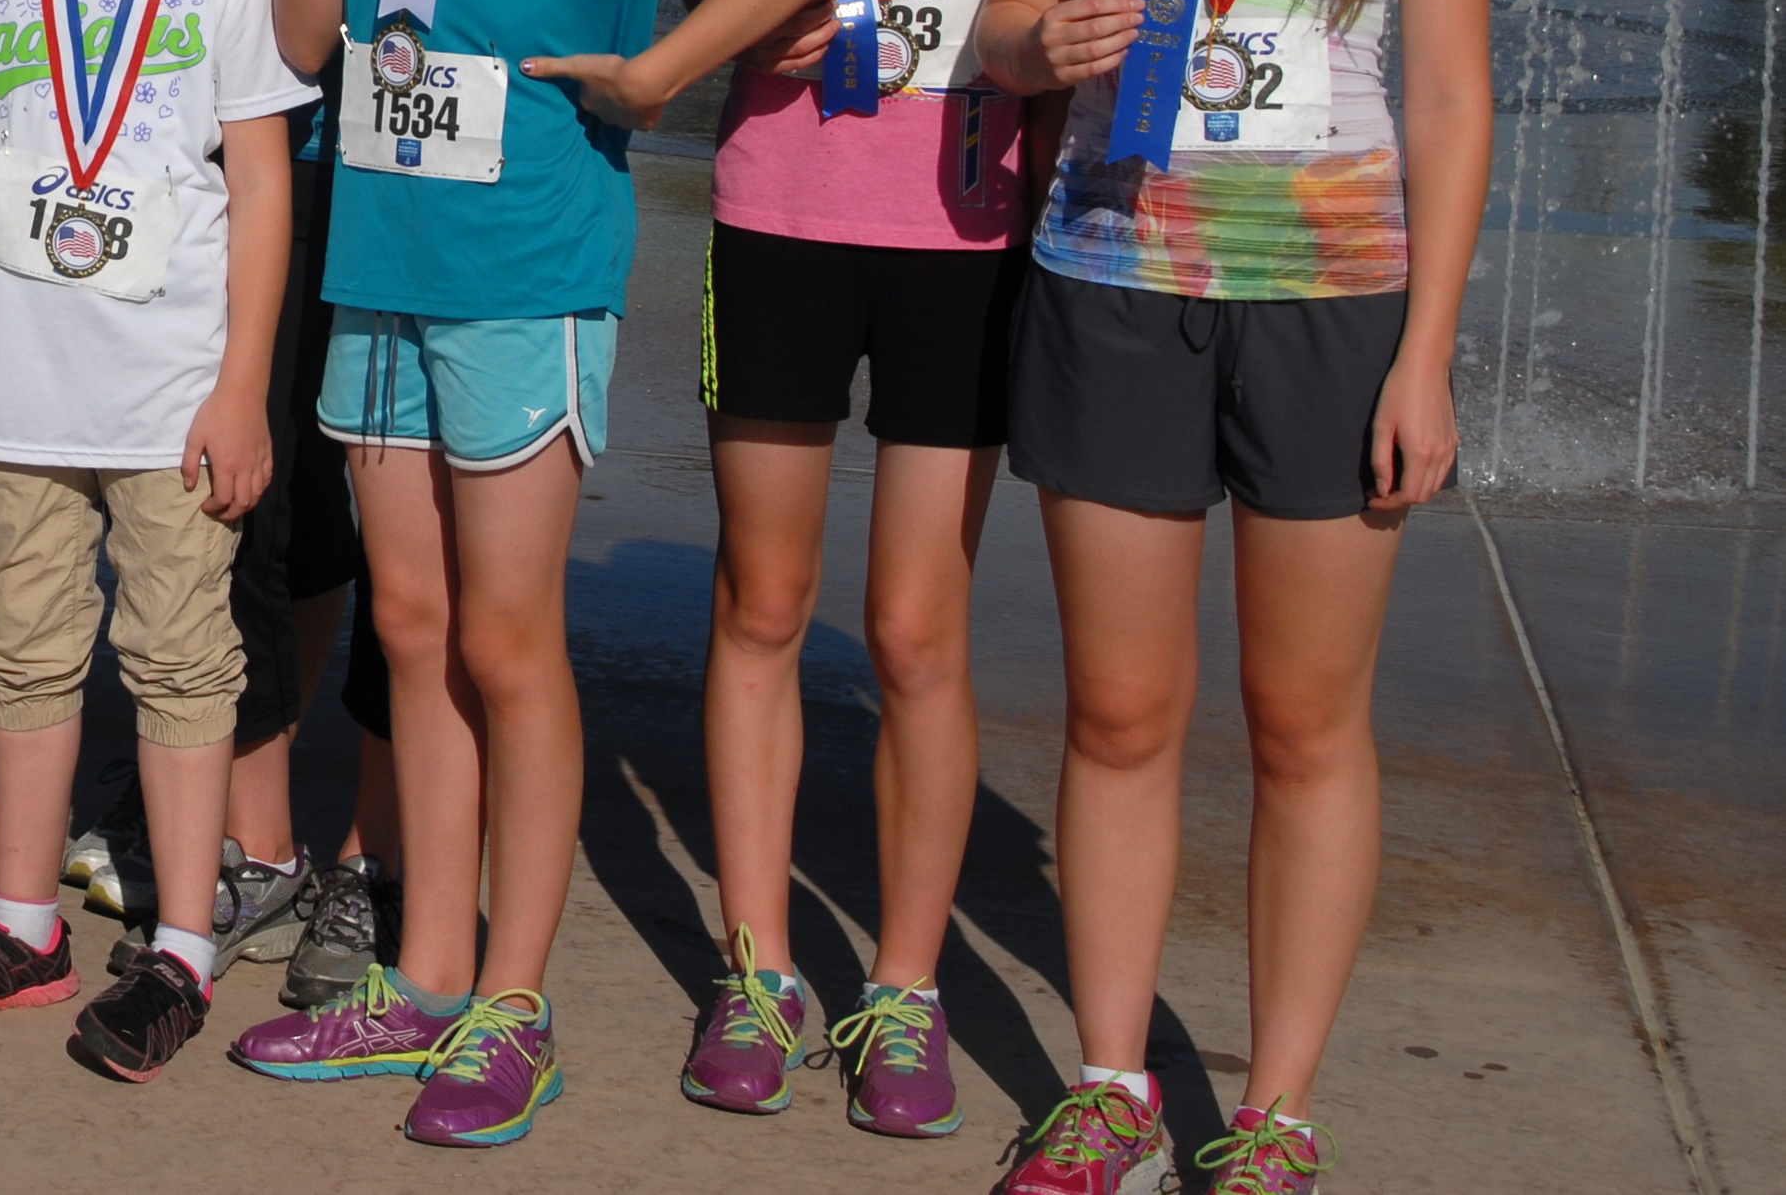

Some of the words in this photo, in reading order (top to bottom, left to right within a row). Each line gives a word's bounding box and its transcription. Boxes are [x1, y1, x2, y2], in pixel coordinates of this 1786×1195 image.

[842, 22, 857, 89] PLACE
[1137, 29, 1182, 49] FIRST
[372, 88, 460, 142] 1534
[1135, 51, 1164, 133] PLACE
[153, 963, 185, 987] FILA
